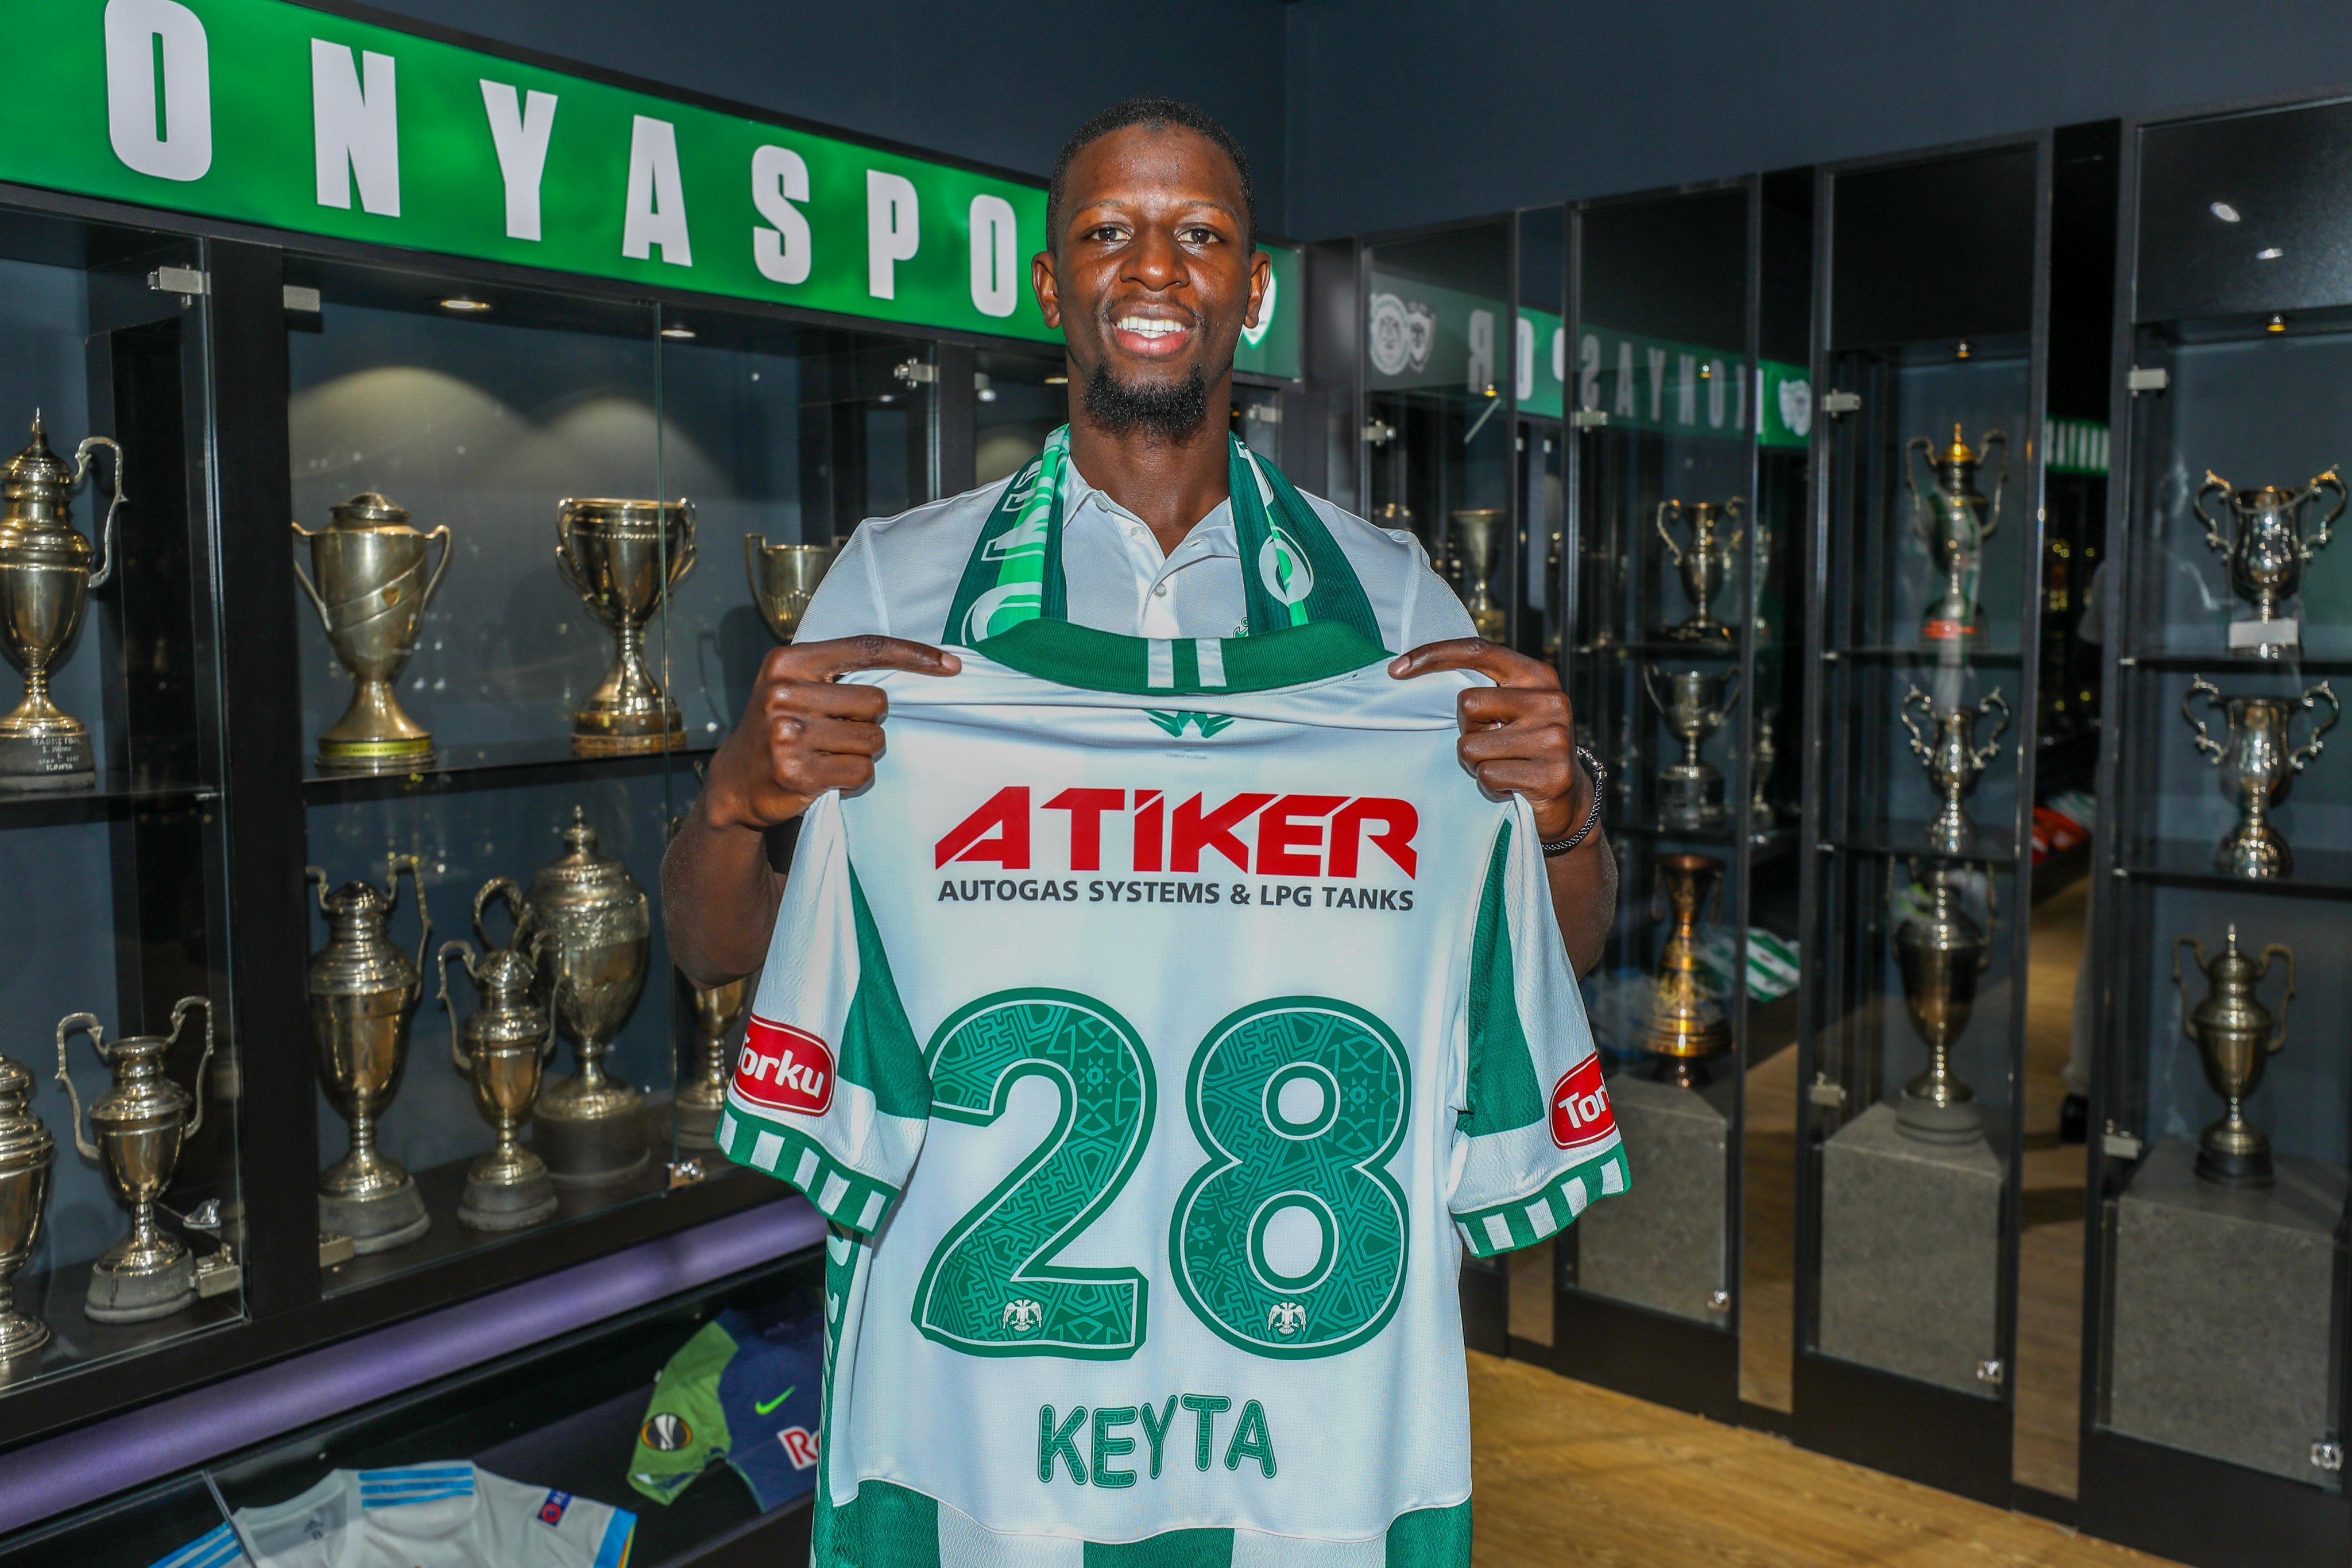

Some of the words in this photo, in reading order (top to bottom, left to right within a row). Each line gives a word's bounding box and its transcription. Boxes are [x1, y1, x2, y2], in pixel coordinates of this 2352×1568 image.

[938, 880, 1078, 901] AUTOGAS
[1089, 880, 1220, 904] SYSTEMS
[1230, 884, 1251, 905] &
[1261, 885, 1312, 907] LPG
[1323, 886, 1414, 911] TANKS
[1558, 1072, 1610, 1129] Tor
[911, 987, 1412, 1361] 28
[1037, 1393, 1278, 1489] KEYTA
